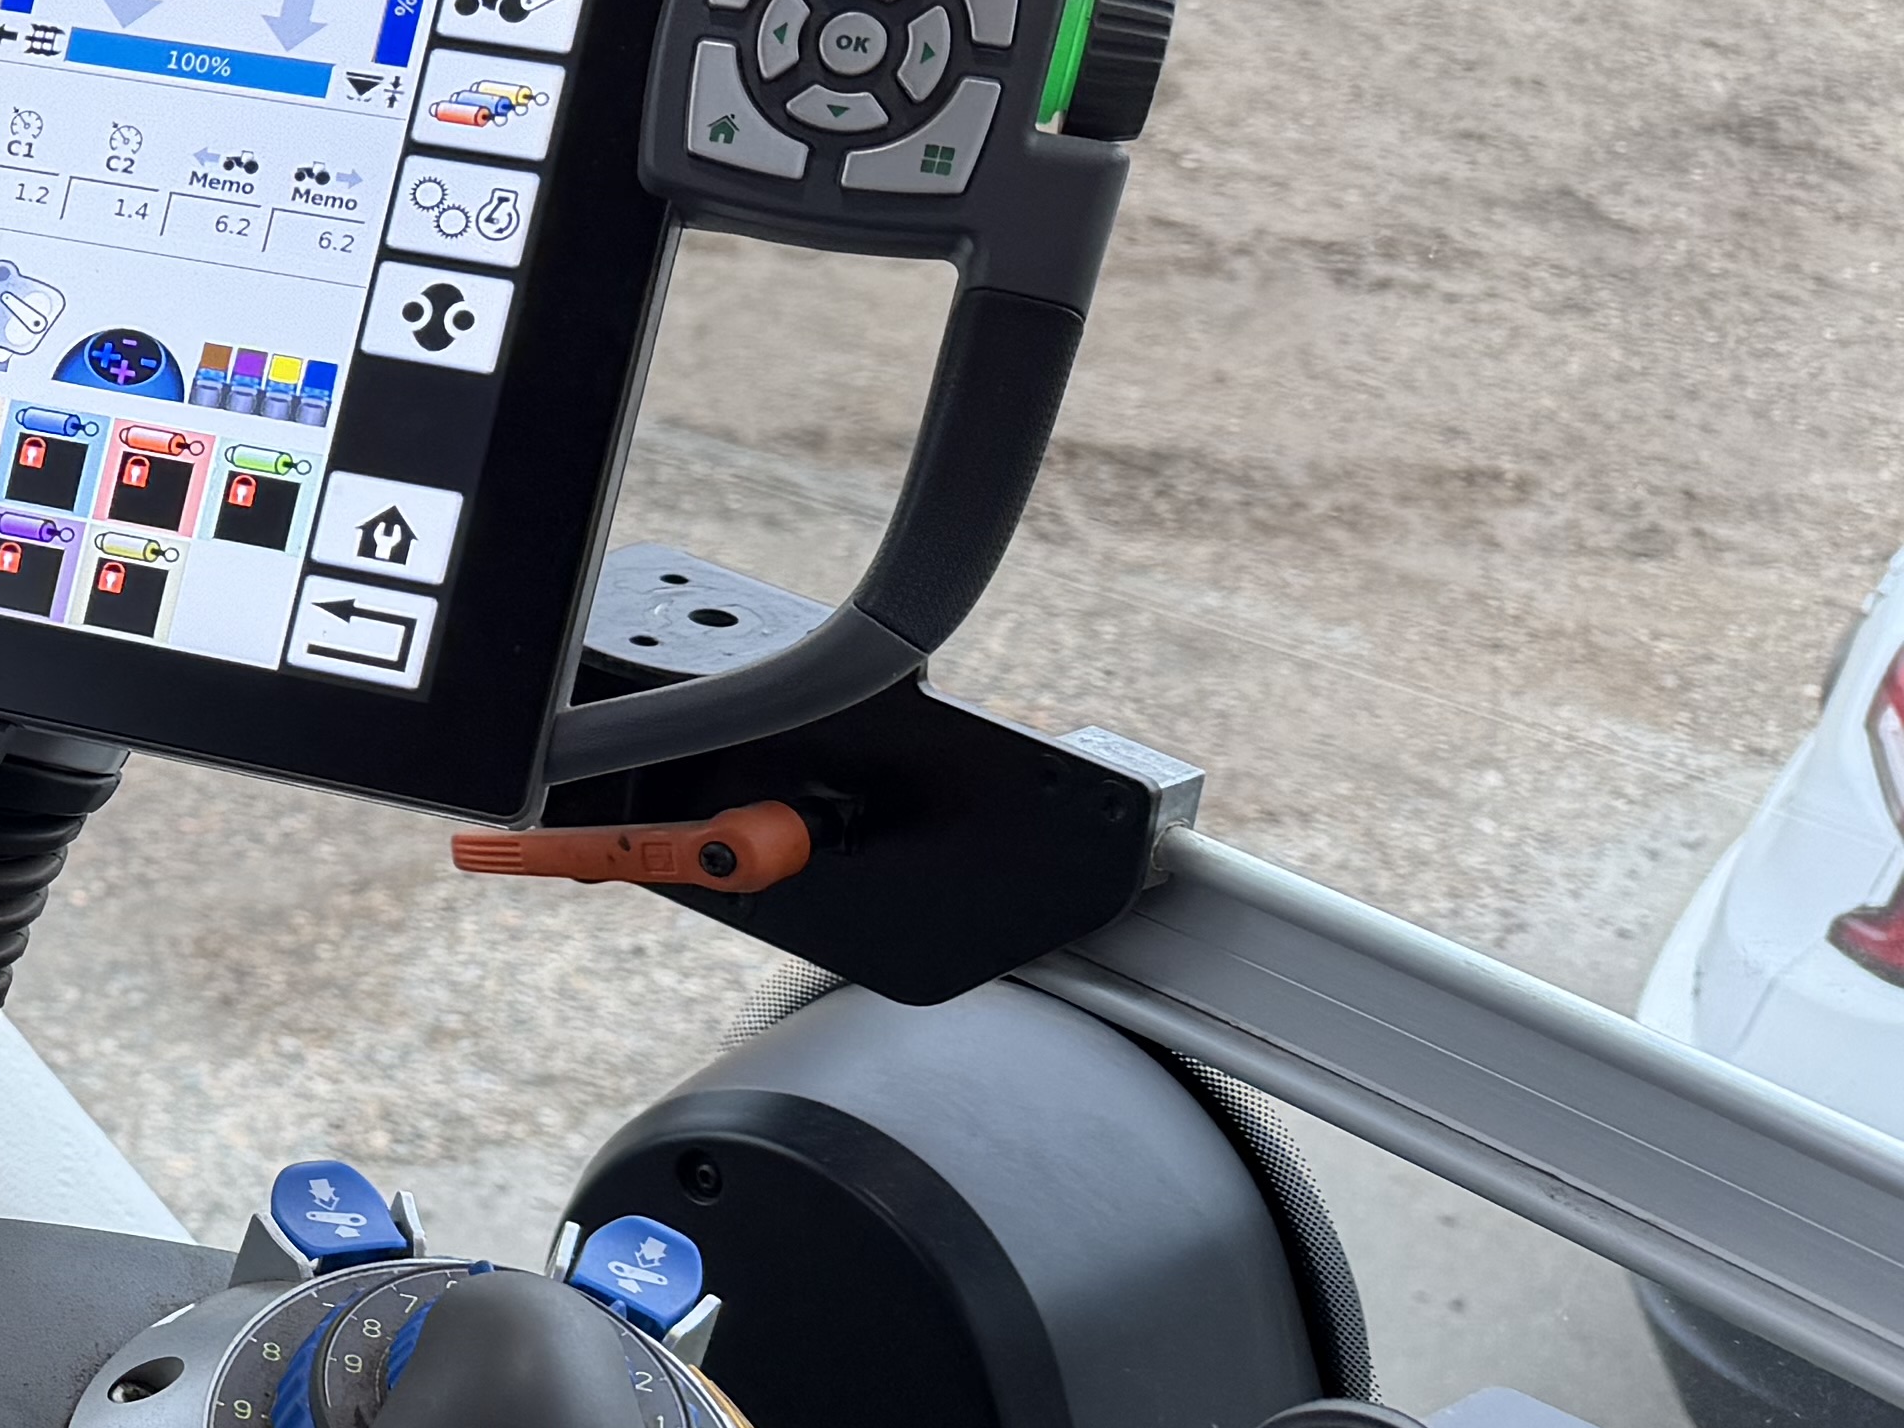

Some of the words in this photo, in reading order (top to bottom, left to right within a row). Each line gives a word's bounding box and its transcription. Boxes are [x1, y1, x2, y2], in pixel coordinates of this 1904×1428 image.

[835, 34, 870, 54] OK
[166, 50, 232, 77] 100%
[7, 139, 35, 158] C1
[106, 155, 135, 174] C2
[15, 182, 50, 205] 1.2
[189, 172, 255, 195] Memo
[114, 198, 149, 220] 1.4
[291, 187, 358, 212] Memo
[215, 215, 251, 237] 6.2
[318, 231, 355, 254] 6.2
[362, 1318, 382, 1338] 8
[262, 1341, 281, 1362] 8
[344, 1354, 363, 1373] 9
[635, 1371, 653, 1392] 2
[233, 1399, 252, 1421] 9
